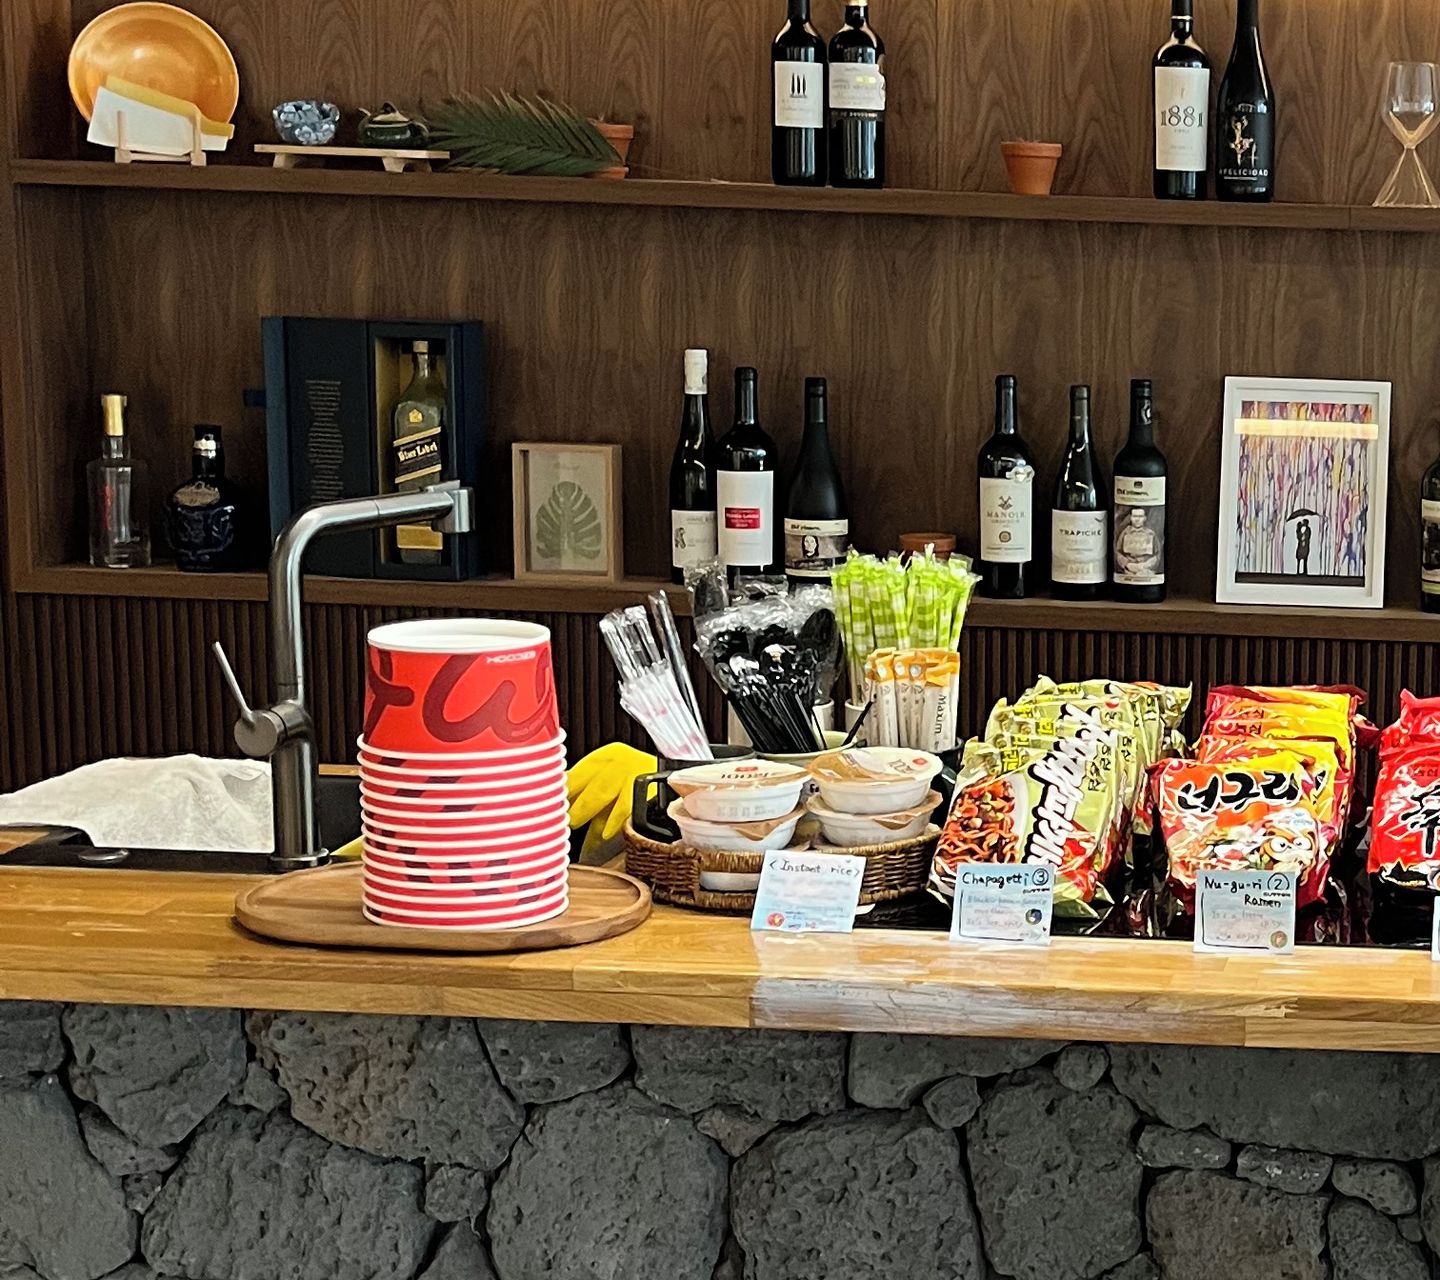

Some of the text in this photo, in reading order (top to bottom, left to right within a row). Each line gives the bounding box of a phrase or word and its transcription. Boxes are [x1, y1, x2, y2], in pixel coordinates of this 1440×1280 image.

[1160, 105, 1204, 128] 1881
[1060, 528, 1102, 536] TRAPICHE
[934, 694, 949, 735] Maxim
[1177, 770, 1300, 813] 너구리
[780, 859, 821, 873] Instant
[1244, 893, 1282, 908] Ramen
